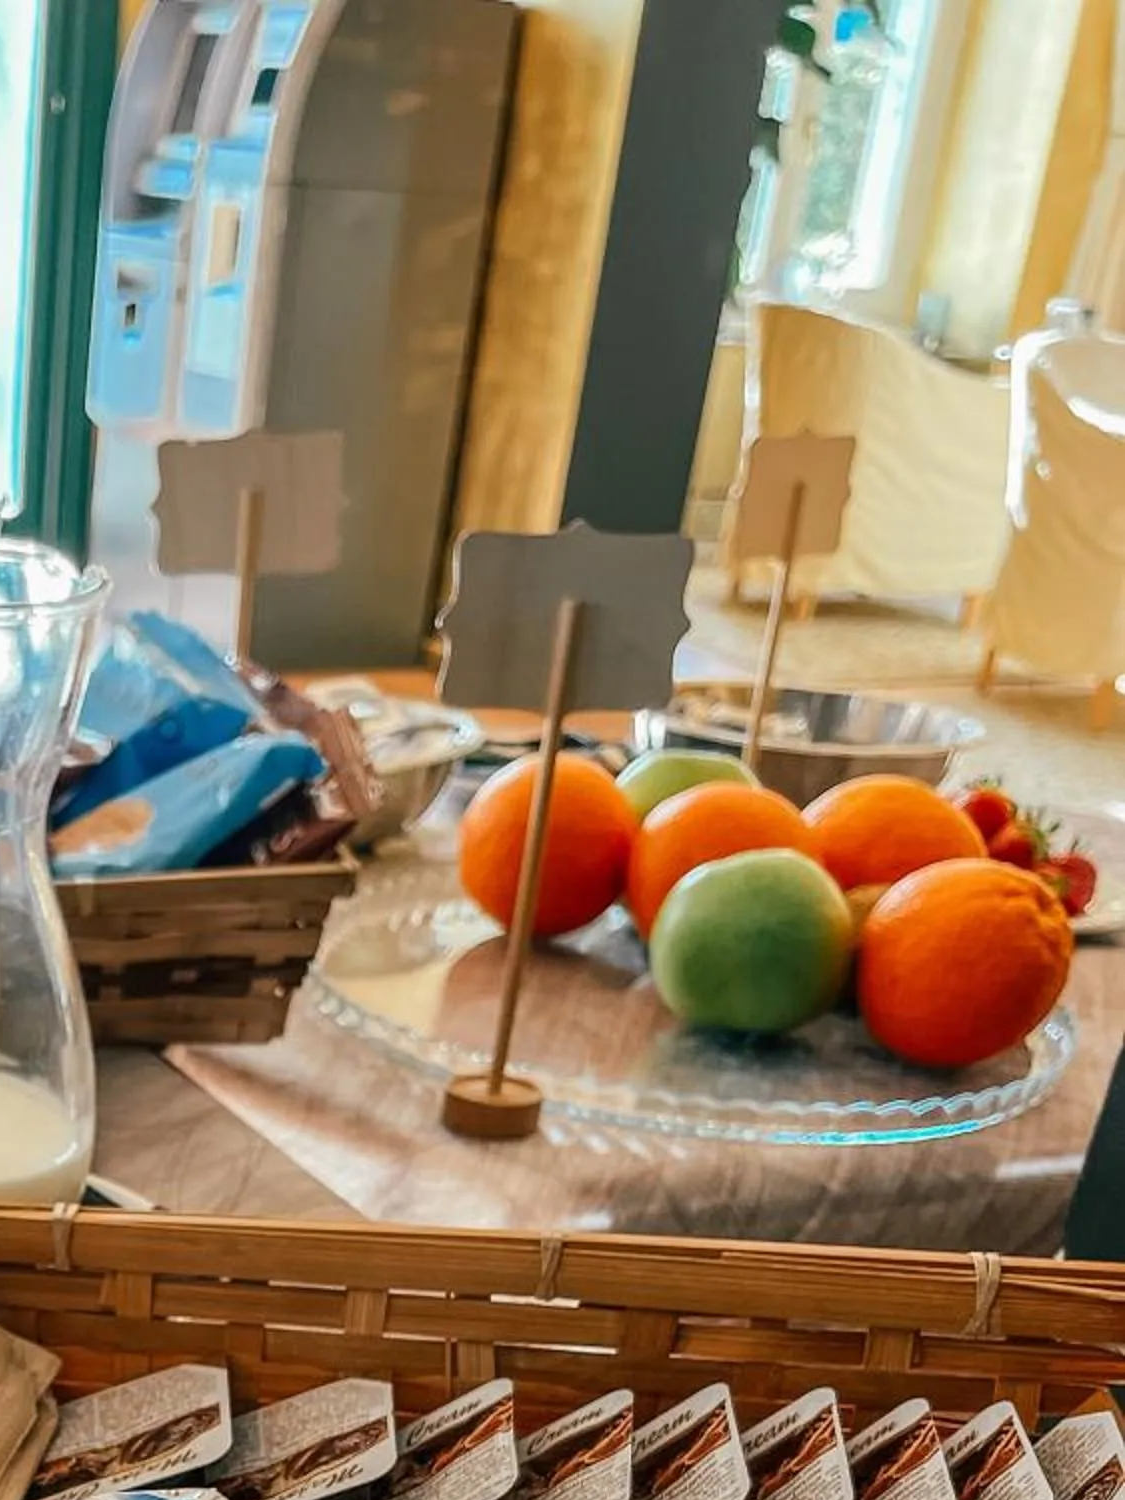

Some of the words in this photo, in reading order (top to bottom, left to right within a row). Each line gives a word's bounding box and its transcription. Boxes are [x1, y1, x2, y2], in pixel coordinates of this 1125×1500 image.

[405, 1398, 482, 1448] Cream
[529, 1407, 603, 1454] Cream
[632, 1408, 694, 1453] ream
[742, 1412, 799, 1451] ream
